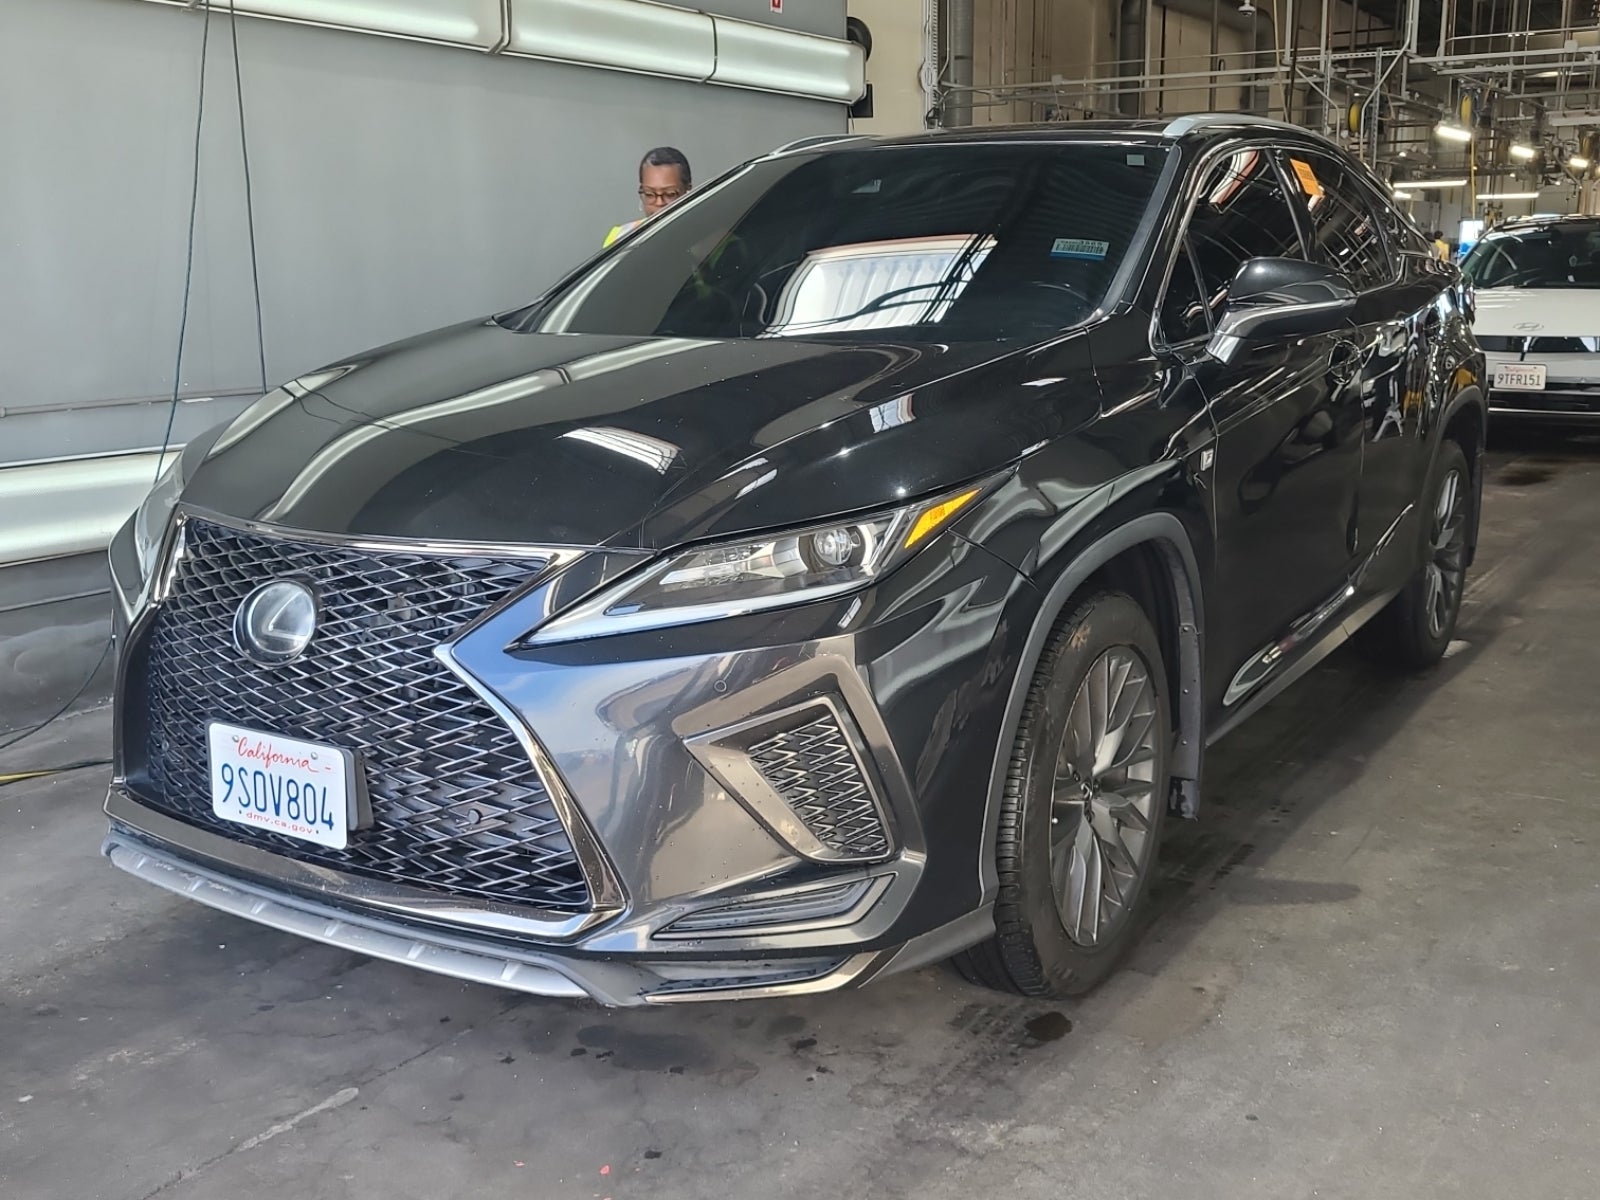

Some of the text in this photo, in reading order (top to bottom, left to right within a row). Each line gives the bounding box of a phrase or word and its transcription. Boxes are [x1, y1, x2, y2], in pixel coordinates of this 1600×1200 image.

[1497, 373, 1541, 386] 9TFR151
[238, 736, 319, 773] California
[221, 763, 334, 831] 9SOV804
[246, 811, 313, 835] dmv.ca.gov
